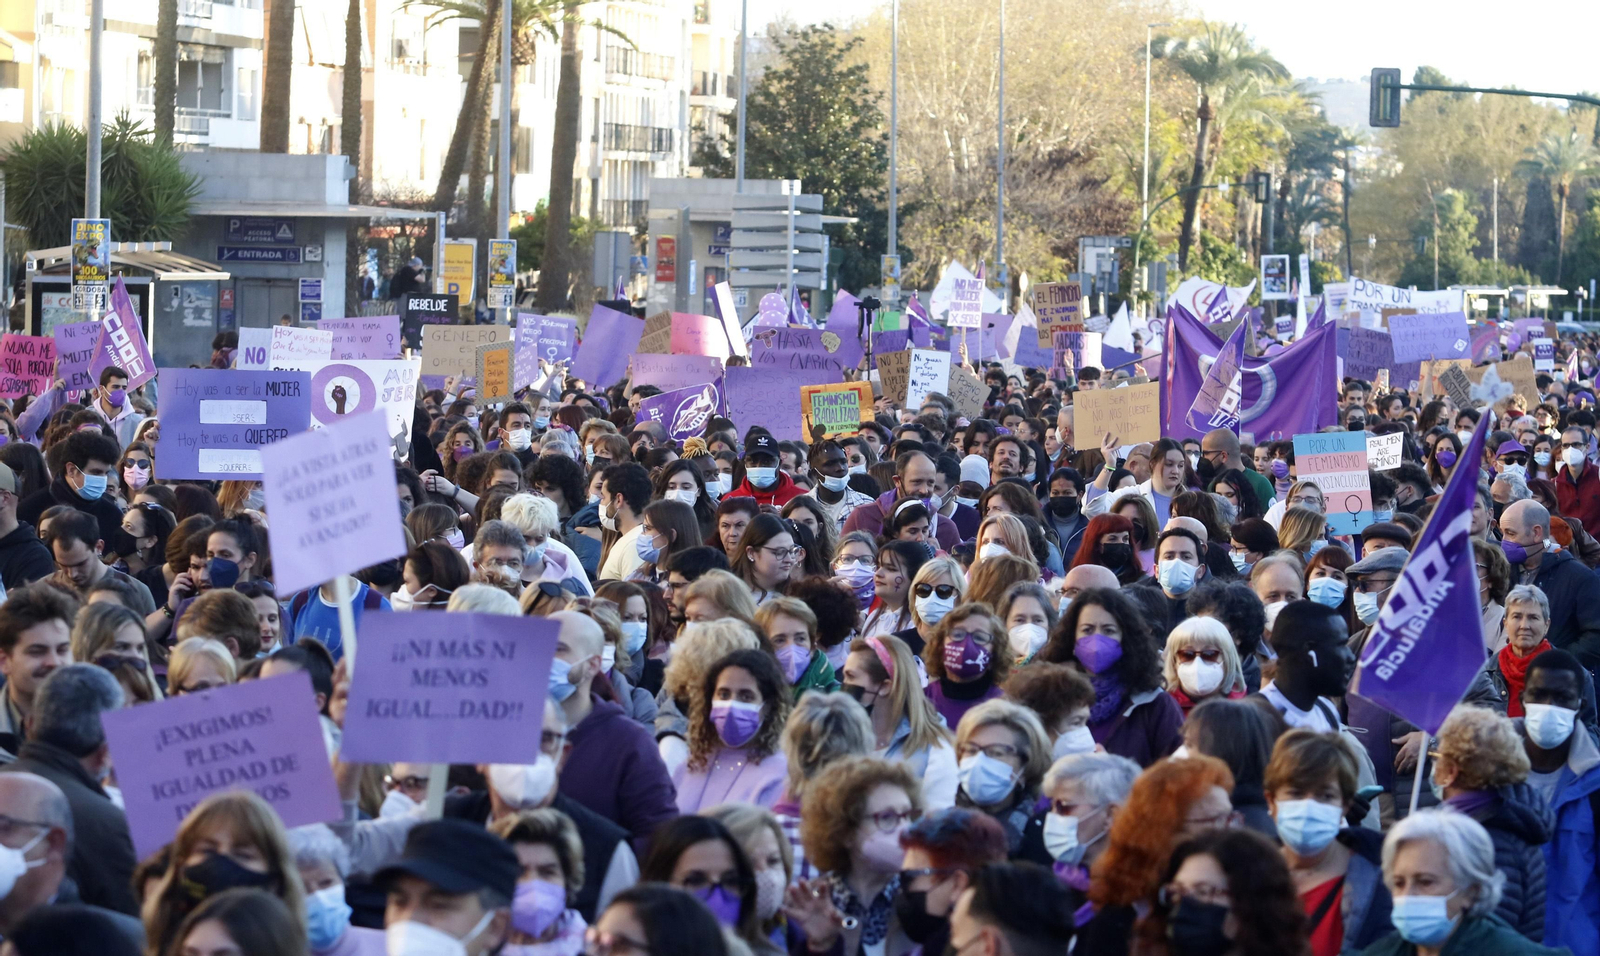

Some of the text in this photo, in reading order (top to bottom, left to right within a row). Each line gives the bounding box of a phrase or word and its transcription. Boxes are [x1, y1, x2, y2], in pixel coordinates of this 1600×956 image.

[77, 223, 104, 232] DINO
[231, 219, 240, 232] P
[76, 232, 104, 240] EXPO
[238, 250, 283, 259] ENTRADA
[81, 266, 98, 276] 100
[955, 279, 966, 290] NO
[1353, 278, 1384, 301] POR
[1391, 288, 1412, 304] UN
[408, 298, 449, 312] REBELDE
[1037, 292, 1048, 304] EL
[950, 313, 959, 324] X
[347, 336, 357, 344] NO
[360, 336, 373, 344] VOY
[778, 330, 815, 351] HASTA
[4, 340, 55, 360] NUNCA ME
[244, 346, 267, 365] NO
[5, 358, 24, 376] SOLA
[880, 352, 904, 368] NO SE
[382, 368, 414, 387] MU
[175, 377, 301, 403] Hoy vas a ser la MUJER
[1129, 389, 1156, 402] MUJER
[813, 392, 857, 408] FEMINISMO
[1115, 421, 1142, 434] VIDA
[178, 432, 198, 453] Hoy
[200, 429, 210, 445] te
[213, 433, 229, 444] vas
[232, 433, 240, 444] a
[1308, 437, 1347, 455] POR UN
[1386, 434, 1402, 446] MEN
[1376, 446, 1390, 457] ARE
[1307, 454, 1361, 473] FEMINISMO
[493, 640, 517, 661] NI
[411, 667, 490, 688] MENOS
[184, 738, 257, 769] PLENA
[150, 754, 301, 802] IGUALDAD DE
